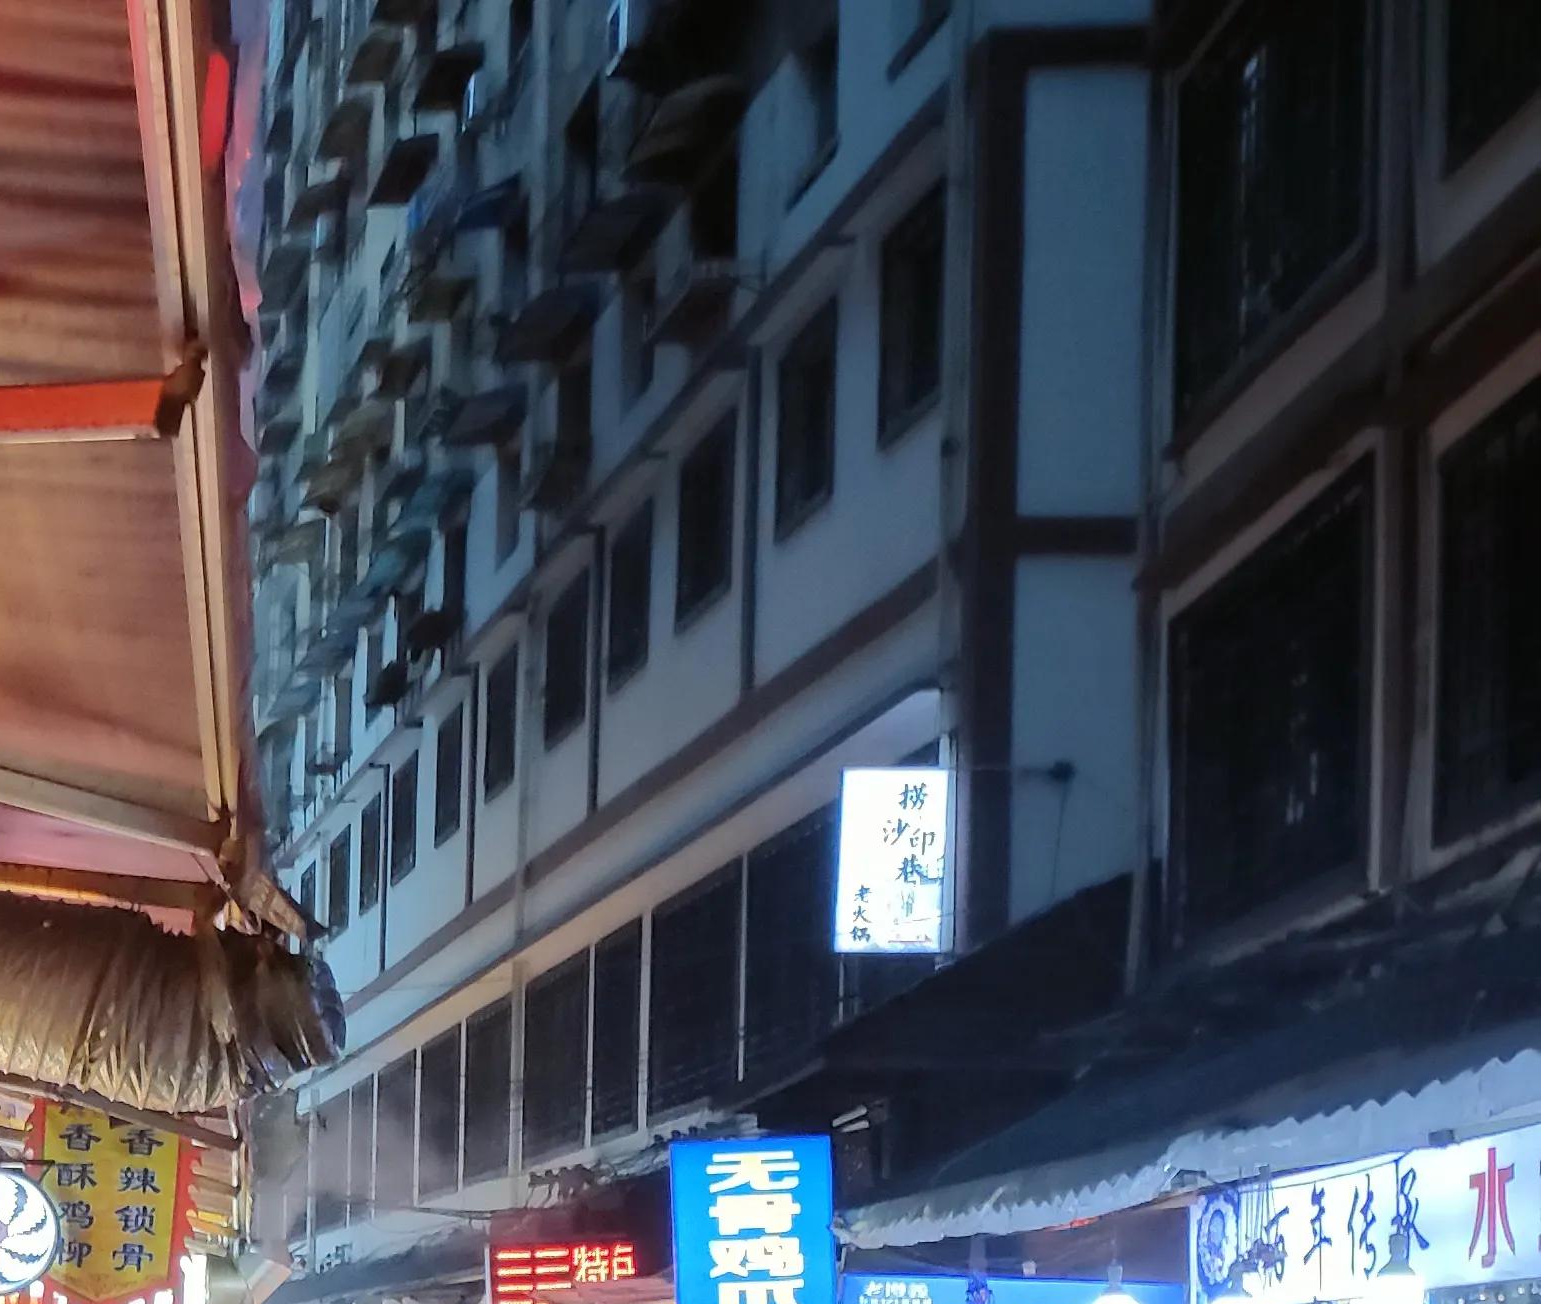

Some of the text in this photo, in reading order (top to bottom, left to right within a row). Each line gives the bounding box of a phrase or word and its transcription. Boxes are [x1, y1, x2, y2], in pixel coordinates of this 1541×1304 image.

[850, 885, 872, 942] 老火锅
[112, 1129, 165, 1273] 香辣锁骨
